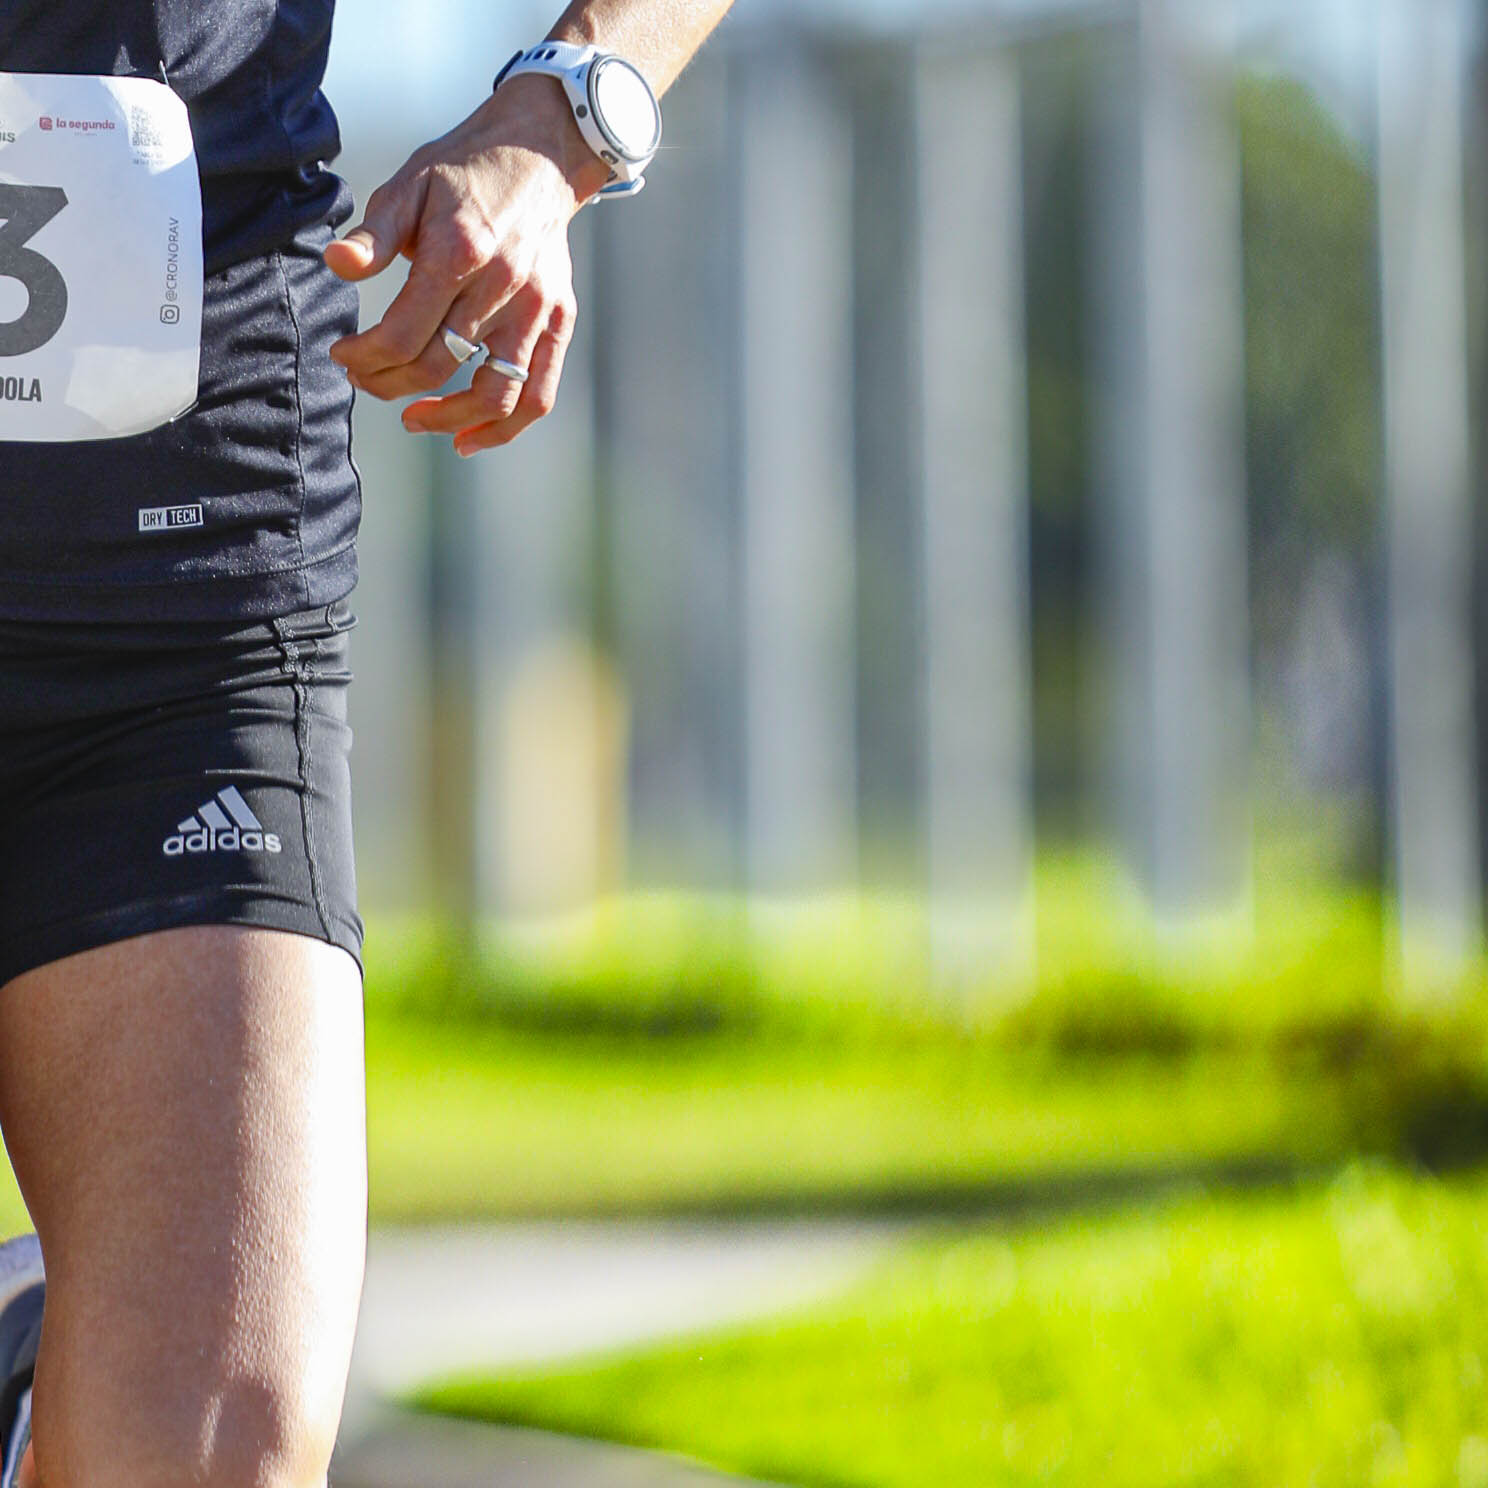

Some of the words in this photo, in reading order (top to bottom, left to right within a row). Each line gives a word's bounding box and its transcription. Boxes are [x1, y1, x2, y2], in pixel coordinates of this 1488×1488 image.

[55, 117, 66, 129] la
[68, 118, 115, 131] segunda
[165, 217, 179, 302] @CRONORAV
[143, 512, 162, 527] DRY
[171, 508, 197, 524] TECH
[162, 825, 282, 856] adidas
